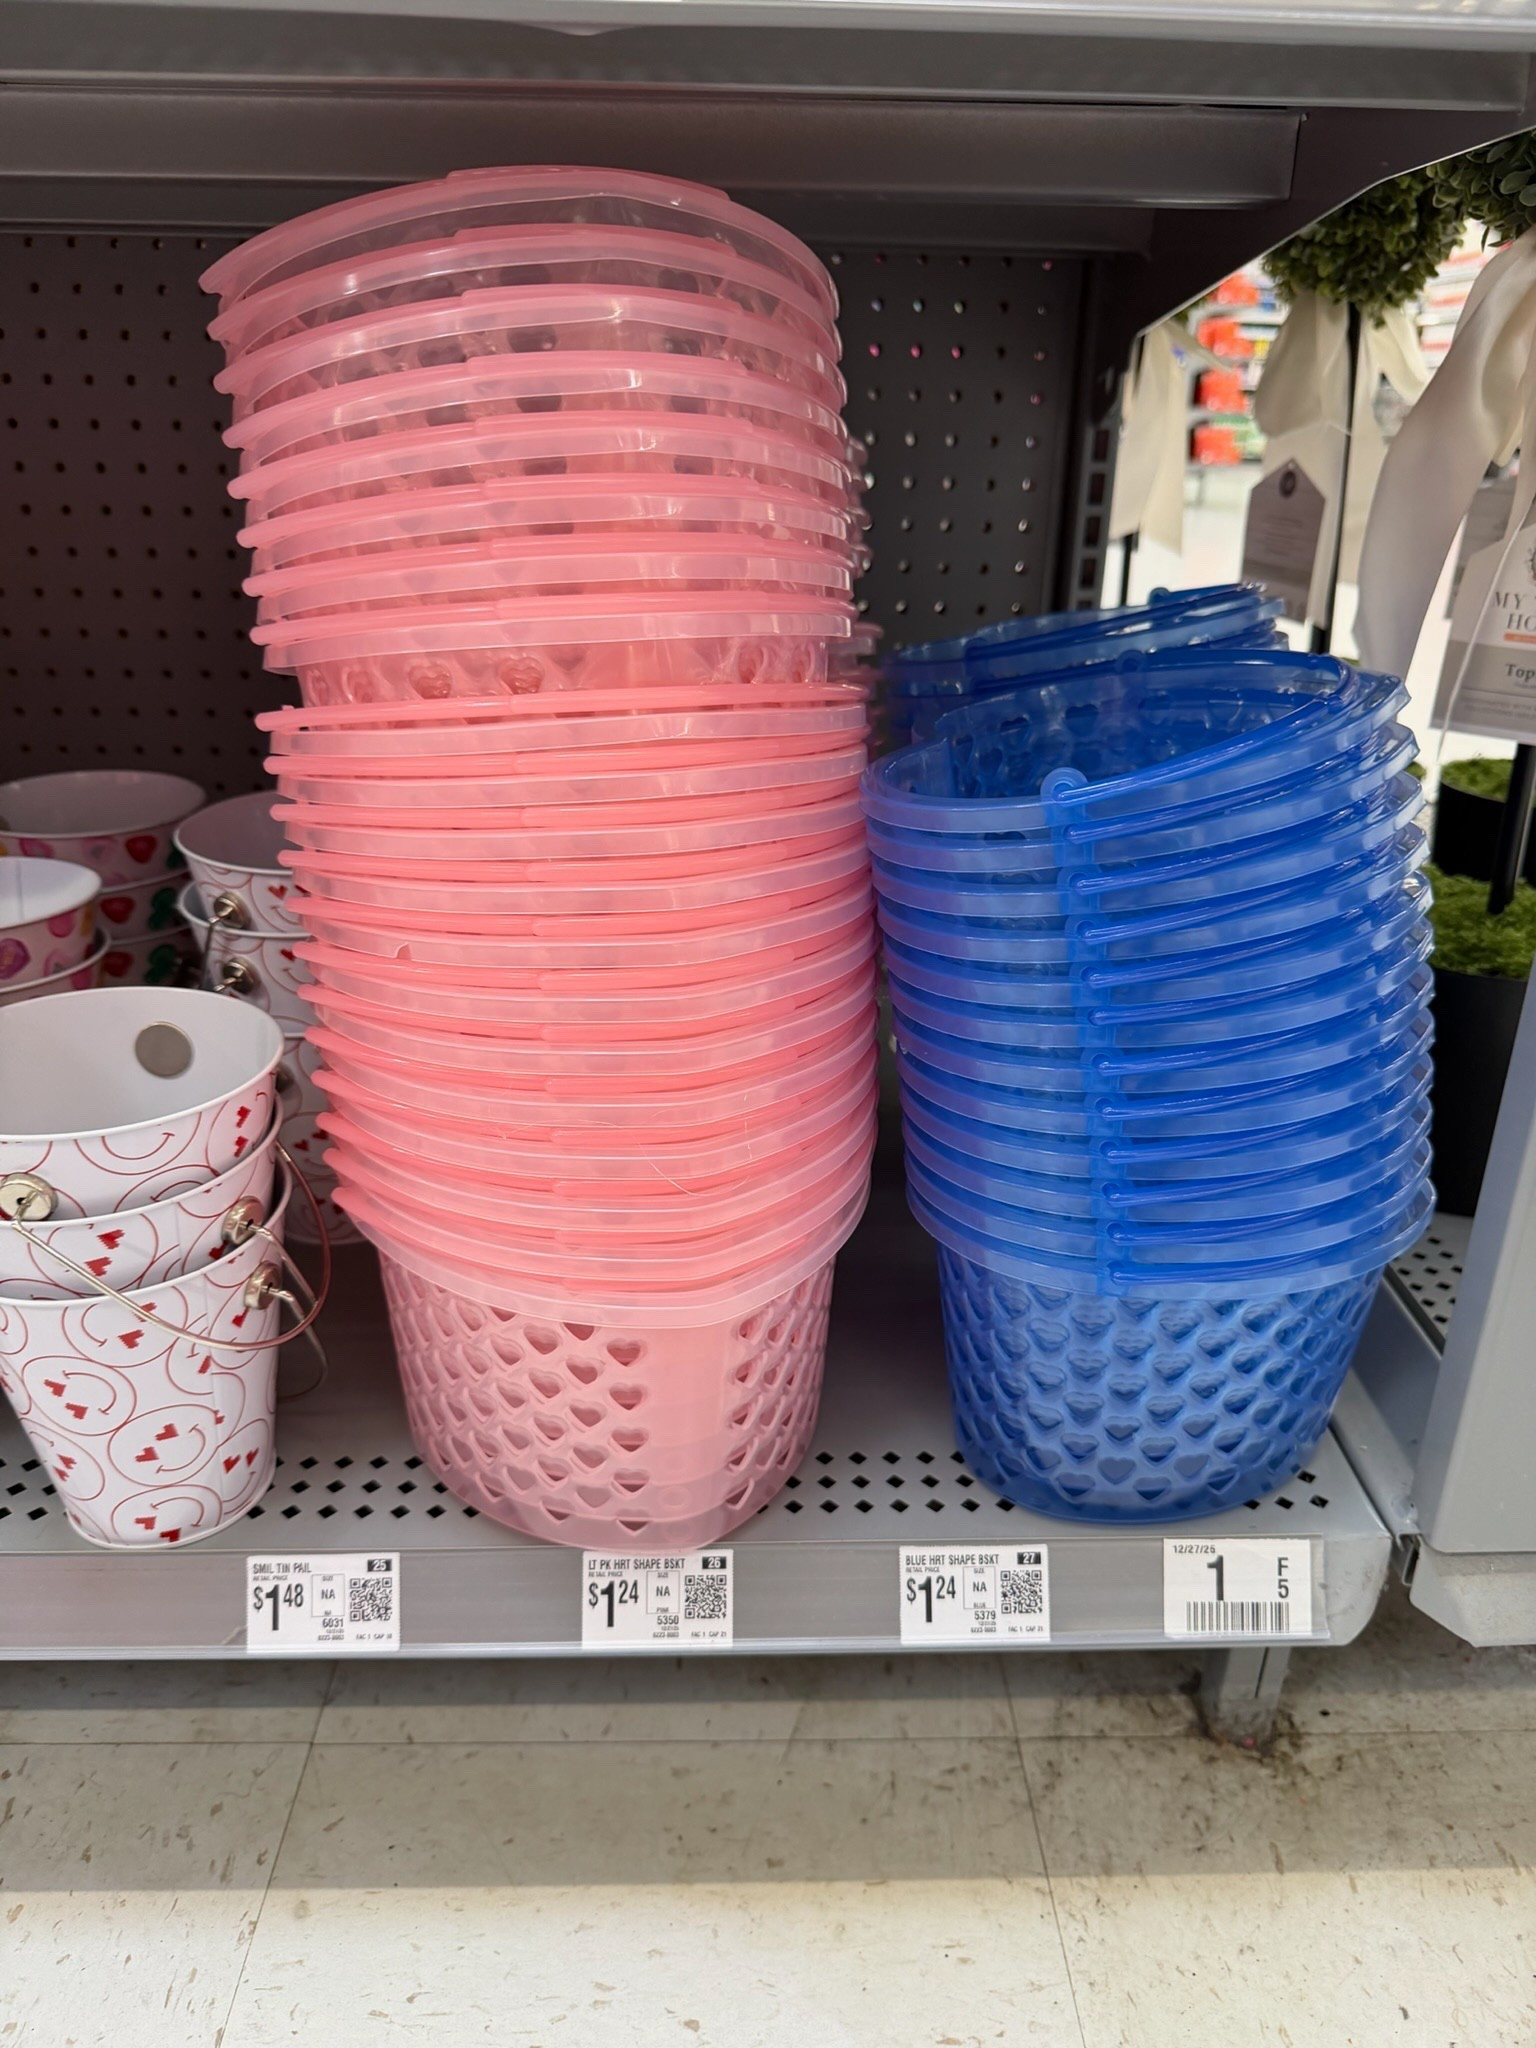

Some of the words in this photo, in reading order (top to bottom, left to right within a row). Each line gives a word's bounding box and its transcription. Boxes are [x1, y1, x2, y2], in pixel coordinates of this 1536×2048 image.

[1493, 592, 1524, 610] MY
[708, 1557, 721, 1568] 26
[905, 1555, 926, 1565] BLUE
[929, 1555, 945, 1565] HRT
[949, 1554, 976, 1565] SHAPE
[978, 1554, 999, 1564] BSKT
[1023, 1552, 1036, 1564] 27
[253, 1563, 274, 1574] SMIL
[276, 1563, 290, 1574] TIN
[293, 1562, 311, 1573] PAIL
[372, 1559, 387, 1571] 25
[588, 1560, 597, 1570] LT
[599, 1560, 611, 1570] PK
[613, 1559, 631, 1569] HRT
[633, 1558, 661, 1569] SHAPE
[664, 1558, 685, 1569] BSKT
[1277, 1557, 1289, 1576] F
[1207, 1555, 1224, 1601] 1
[656, 1586, 670, 1597] NA
[972, 1582, 987, 1592] NA
[1278, 1579, 1289, 1599] 5
[321, 1589, 336, 1599] NA
[657, 1615, 679, 1625] 5350
[974, 1611, 996, 1620] 5379
[322, 1618, 344, 1628] 6031
